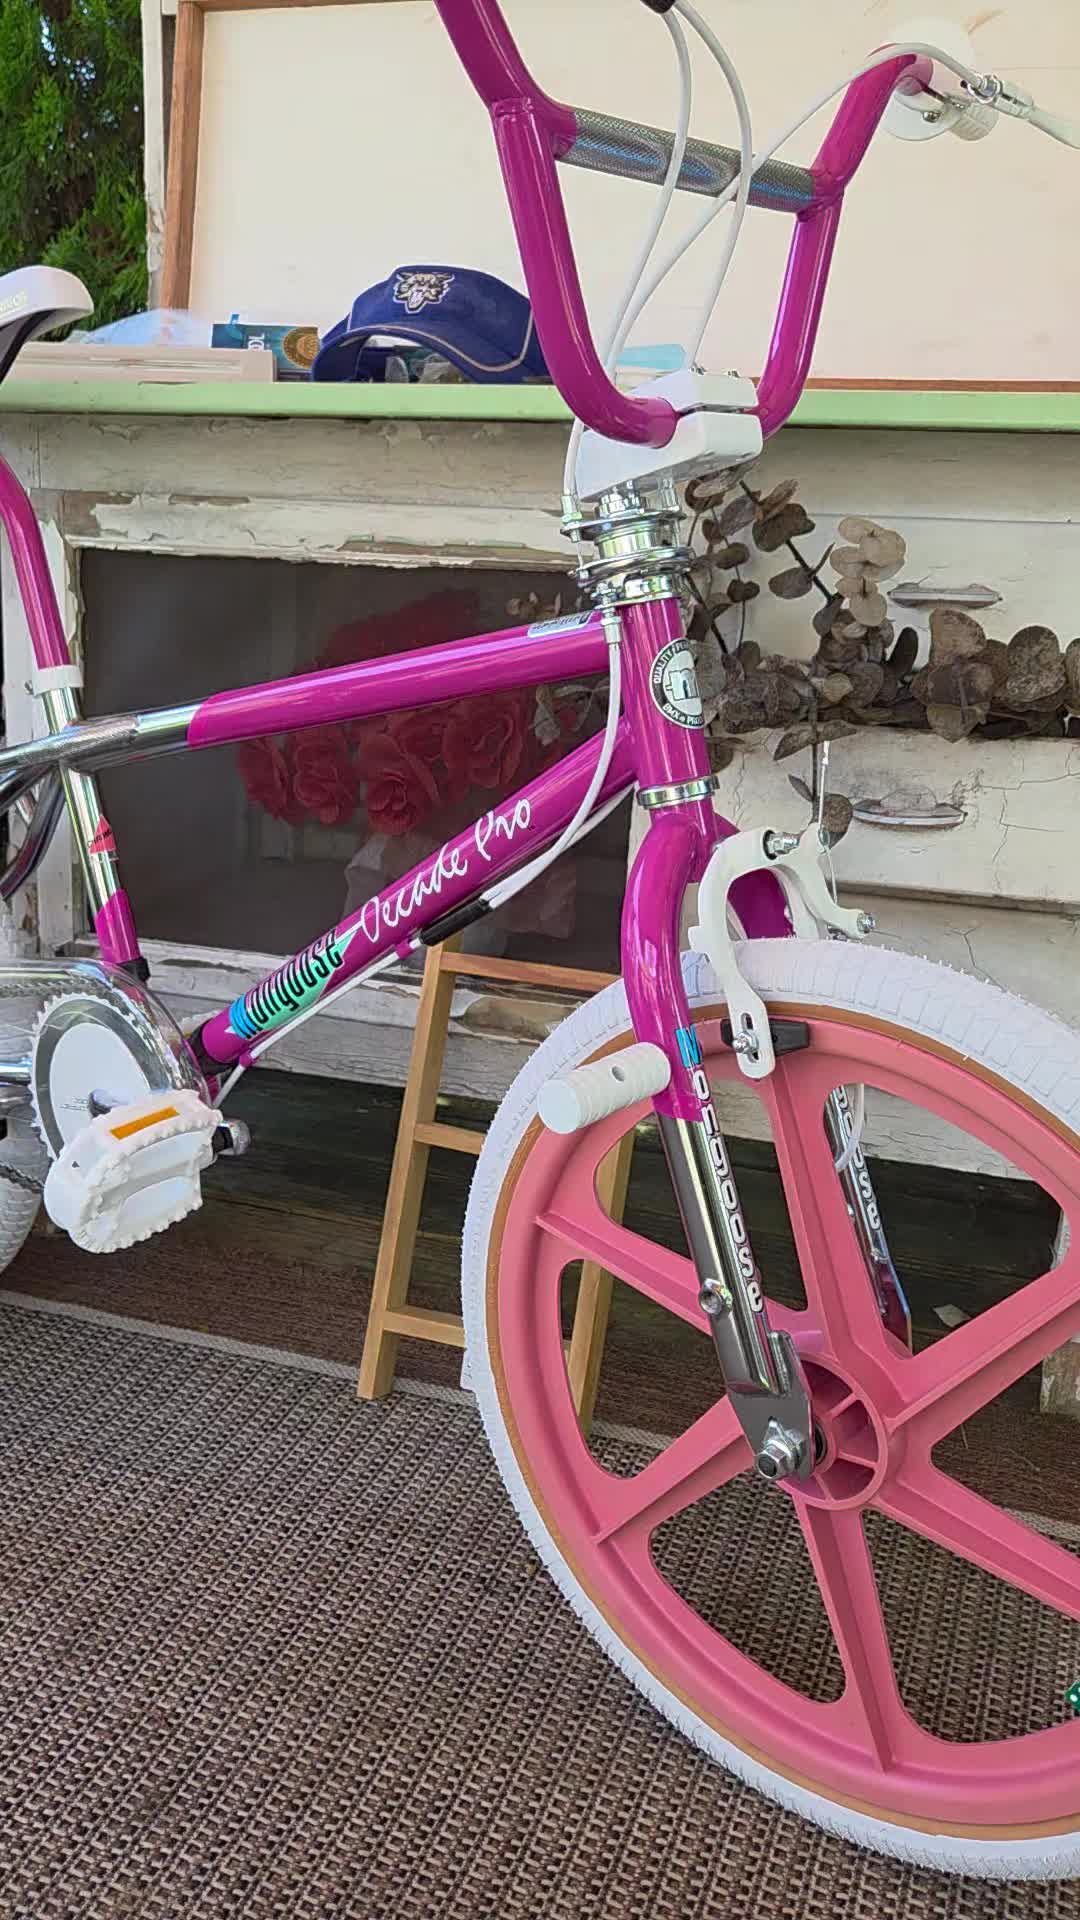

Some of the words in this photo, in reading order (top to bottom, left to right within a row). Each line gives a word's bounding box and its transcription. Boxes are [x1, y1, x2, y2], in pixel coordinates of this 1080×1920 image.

[360, 842, 468, 943] Decade
[474, 799, 531, 861] Pro
[675, 1023, 764, 1314] Mongoose
